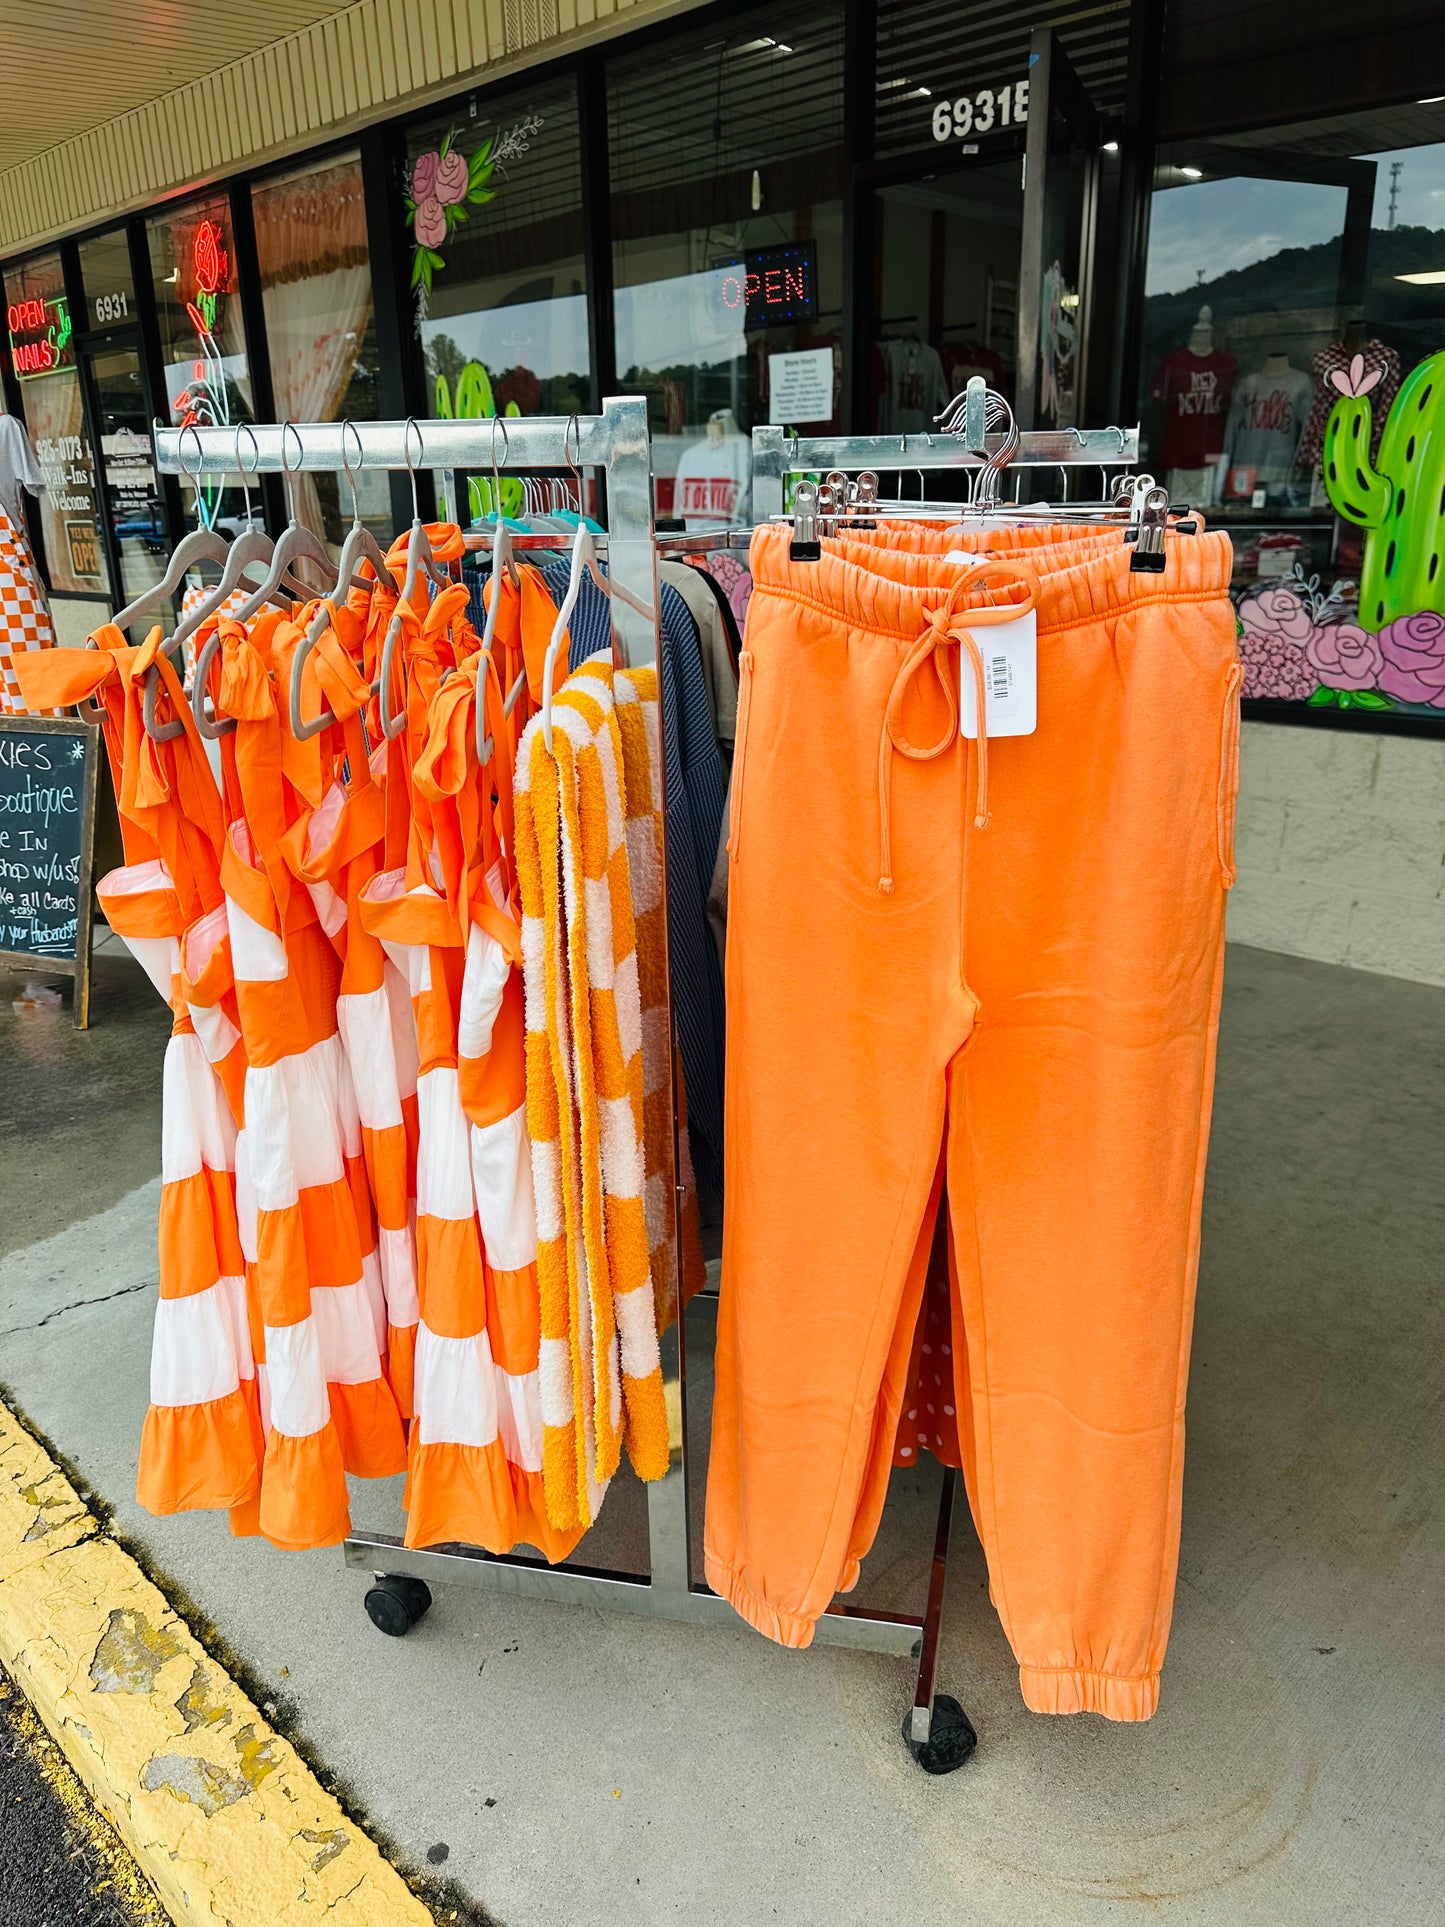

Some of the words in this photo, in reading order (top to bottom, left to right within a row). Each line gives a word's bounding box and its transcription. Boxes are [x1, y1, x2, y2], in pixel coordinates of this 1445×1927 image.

[722, 266, 804, 308] OPEN
[8, 298, 46, 332] OPEN
[96, 291, 128, 322] 6931
[13, 340, 52, 372] NAILS
[36, 436, 83, 462] 925-0173
[40, 465, 88, 487] Walk-Ins
[48, 490, 91, 511] Welcome
[71, 541, 99, 572] OPE
[20, 891, 40, 908] all
